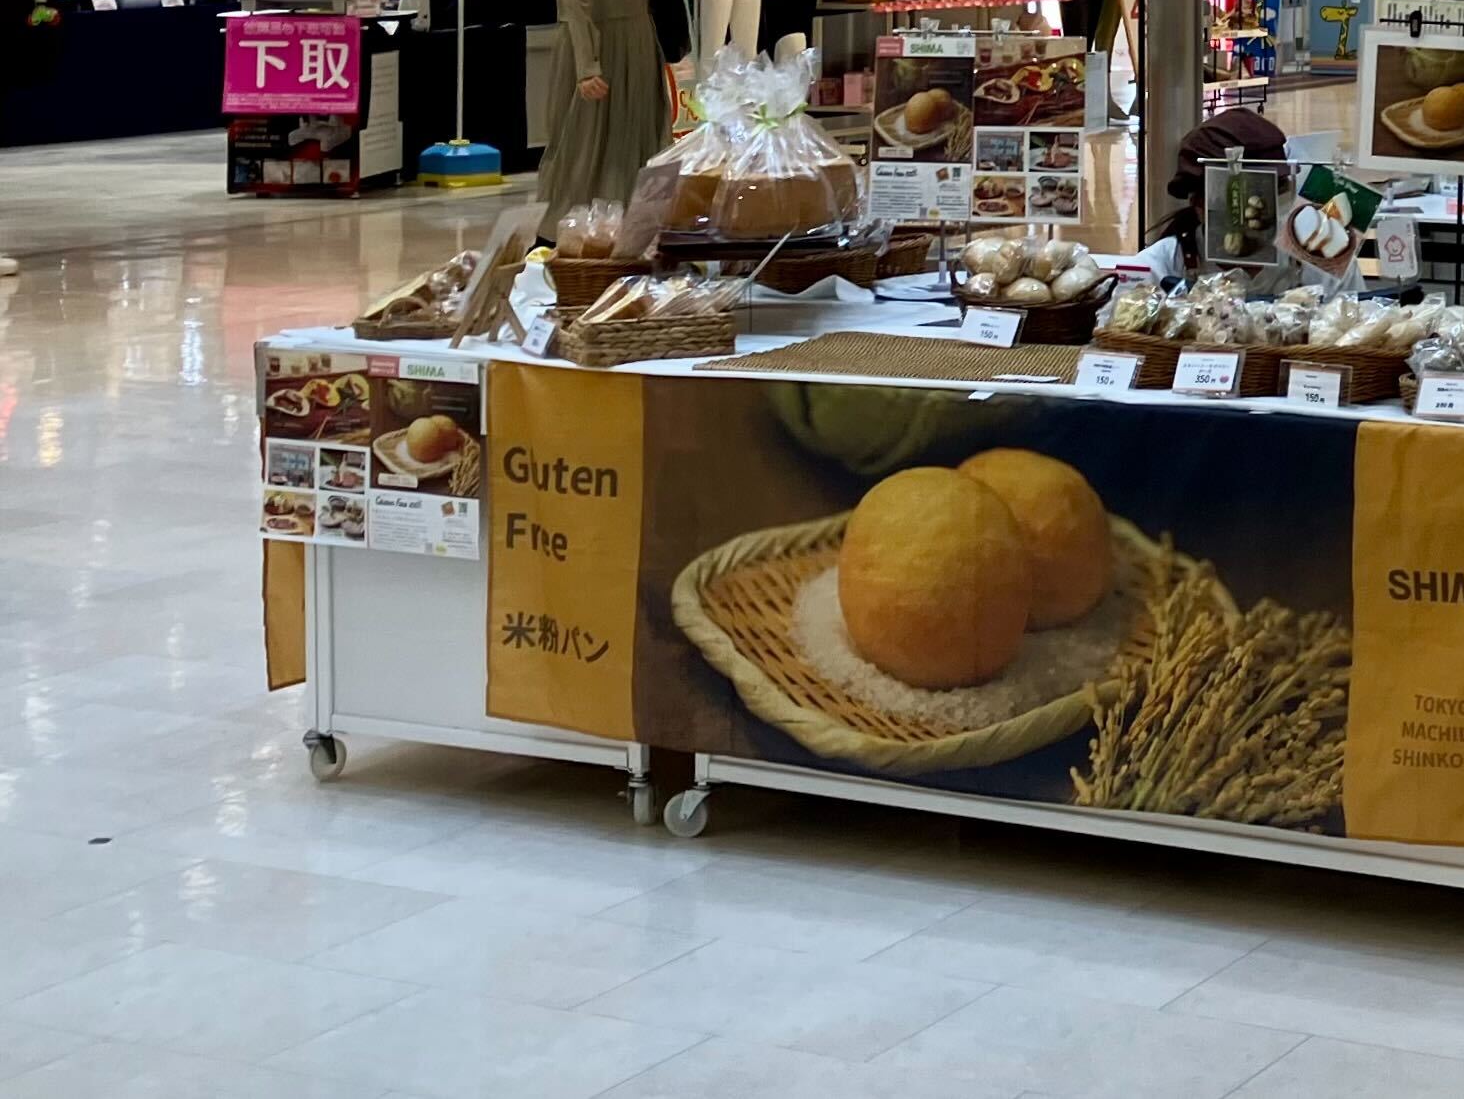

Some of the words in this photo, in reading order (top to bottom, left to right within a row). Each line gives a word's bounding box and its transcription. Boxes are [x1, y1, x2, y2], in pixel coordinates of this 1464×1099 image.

[238, 38, 351, 89] 下取
[407, 364, 446, 378] SHIMA
[501, 610, 610, 664] 米粉パン
